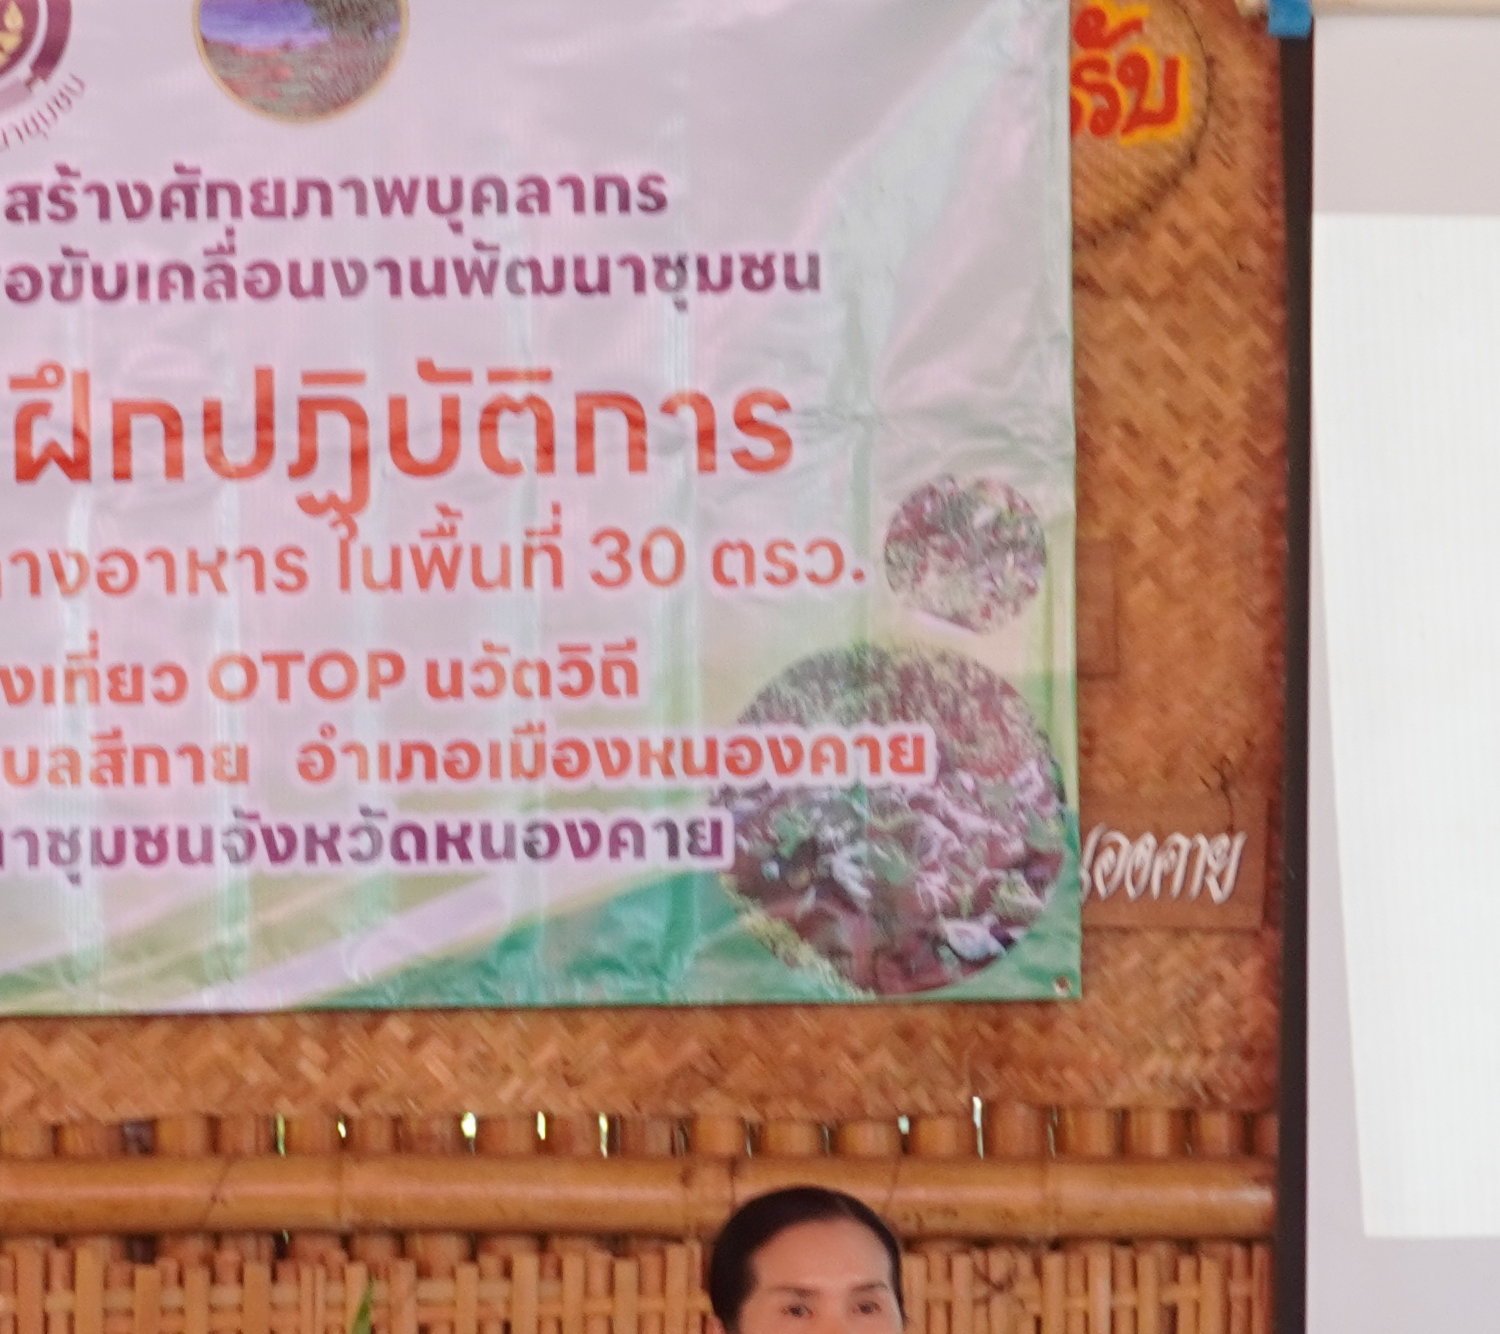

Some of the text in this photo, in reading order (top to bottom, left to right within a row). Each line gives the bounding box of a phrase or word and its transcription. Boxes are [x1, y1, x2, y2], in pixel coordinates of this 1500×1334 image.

[319, 503, 566, 593] ในพื้นที่
[589, 525, 687, 590] 30
[711, 536, 867, 587] ตรว.
[207, 650, 407, 704] OTOP
[425, 638, 641, 703] นวัตวิถี
[295, 720, 927, 785] อำเภอเมืองหนองคาย
